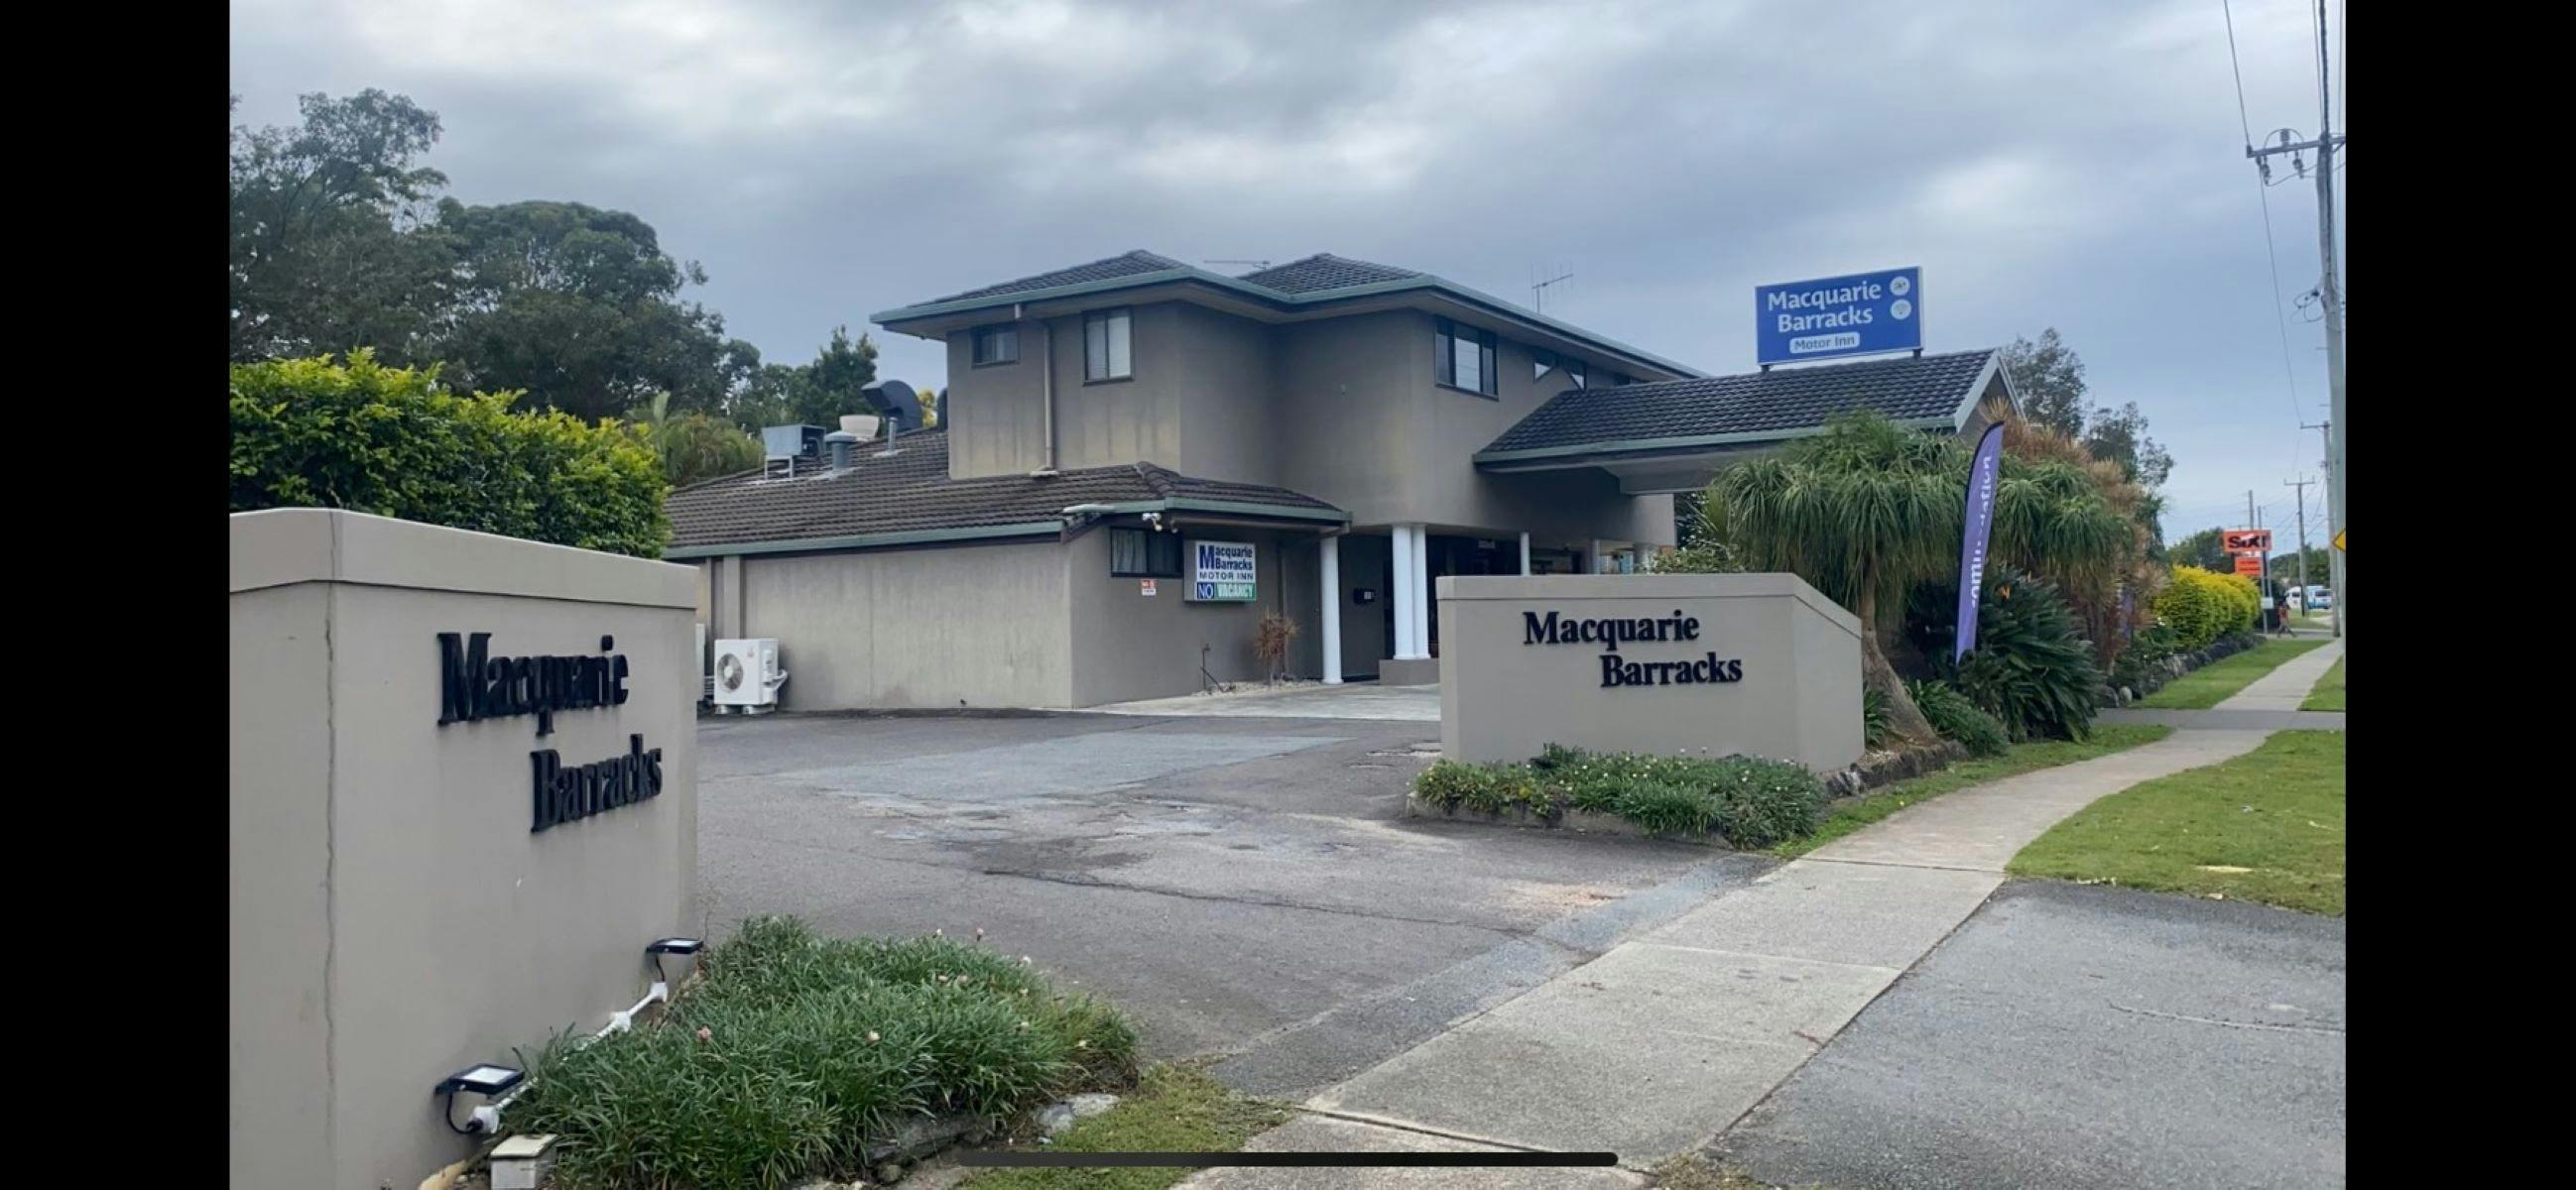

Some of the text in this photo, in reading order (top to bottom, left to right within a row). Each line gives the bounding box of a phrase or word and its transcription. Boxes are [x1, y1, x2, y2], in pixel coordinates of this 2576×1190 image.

[1768, 281, 1882, 310] Macquarie
[1778, 305, 1874, 333] Barracks
[1794, 335, 1855, 351] Motor Inn
[1199, 571, 1234, 580] MOTOR
[1215, 556, 1253, 570] Barracks
[1197, 584, 1253, 599] NO VACANCY
[1523, 609, 1700, 652] Macquarie
[1599, 652, 1743, 688] Barracks
[436, 632, 629, 737] Macquarie
[530, 733, 663, 834] Barracks
